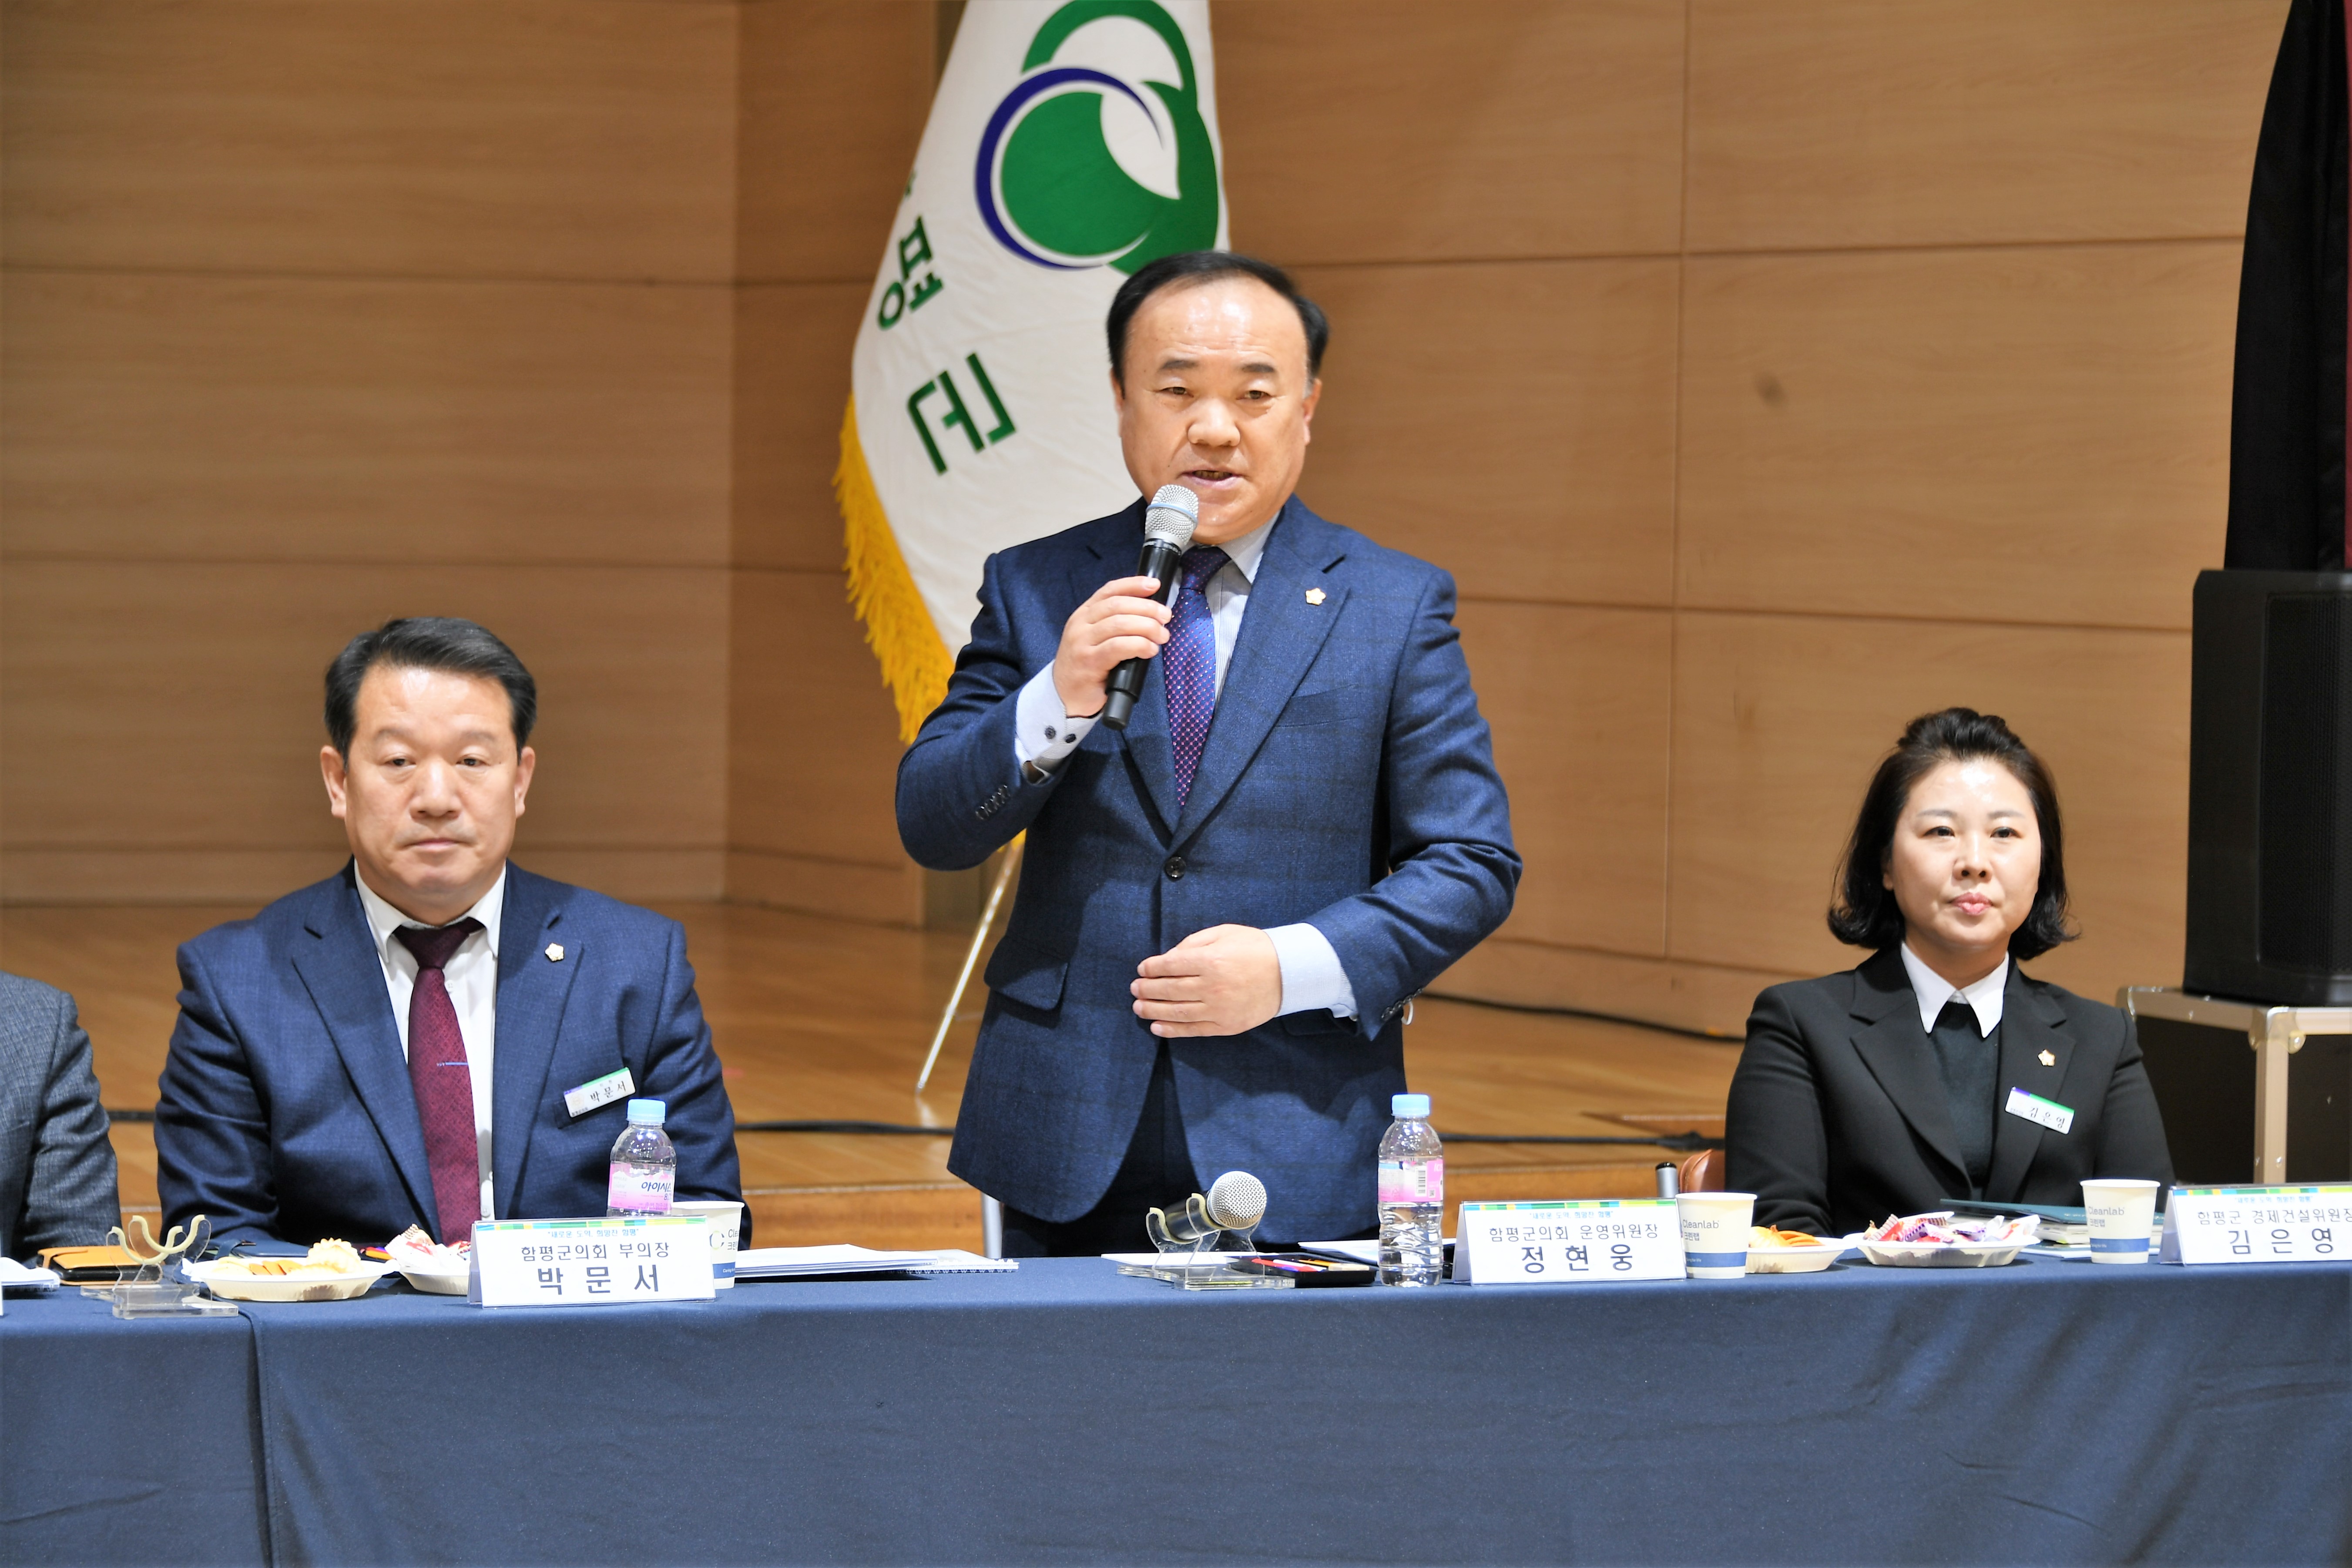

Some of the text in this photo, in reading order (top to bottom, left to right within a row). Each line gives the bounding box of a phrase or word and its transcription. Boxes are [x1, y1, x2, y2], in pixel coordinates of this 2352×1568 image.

[2089, 1206, 2124, 1215] Cleanlab
[2198, 1209, 2352, 1225] 함평군 경제건설위원장
[1683, 1219, 1718, 1229] Cleanlab
[1489, 1224, 1657, 1242] 함평군의회 운영위원장
[521, 1242, 669, 1262] 함평군의회 부의장
